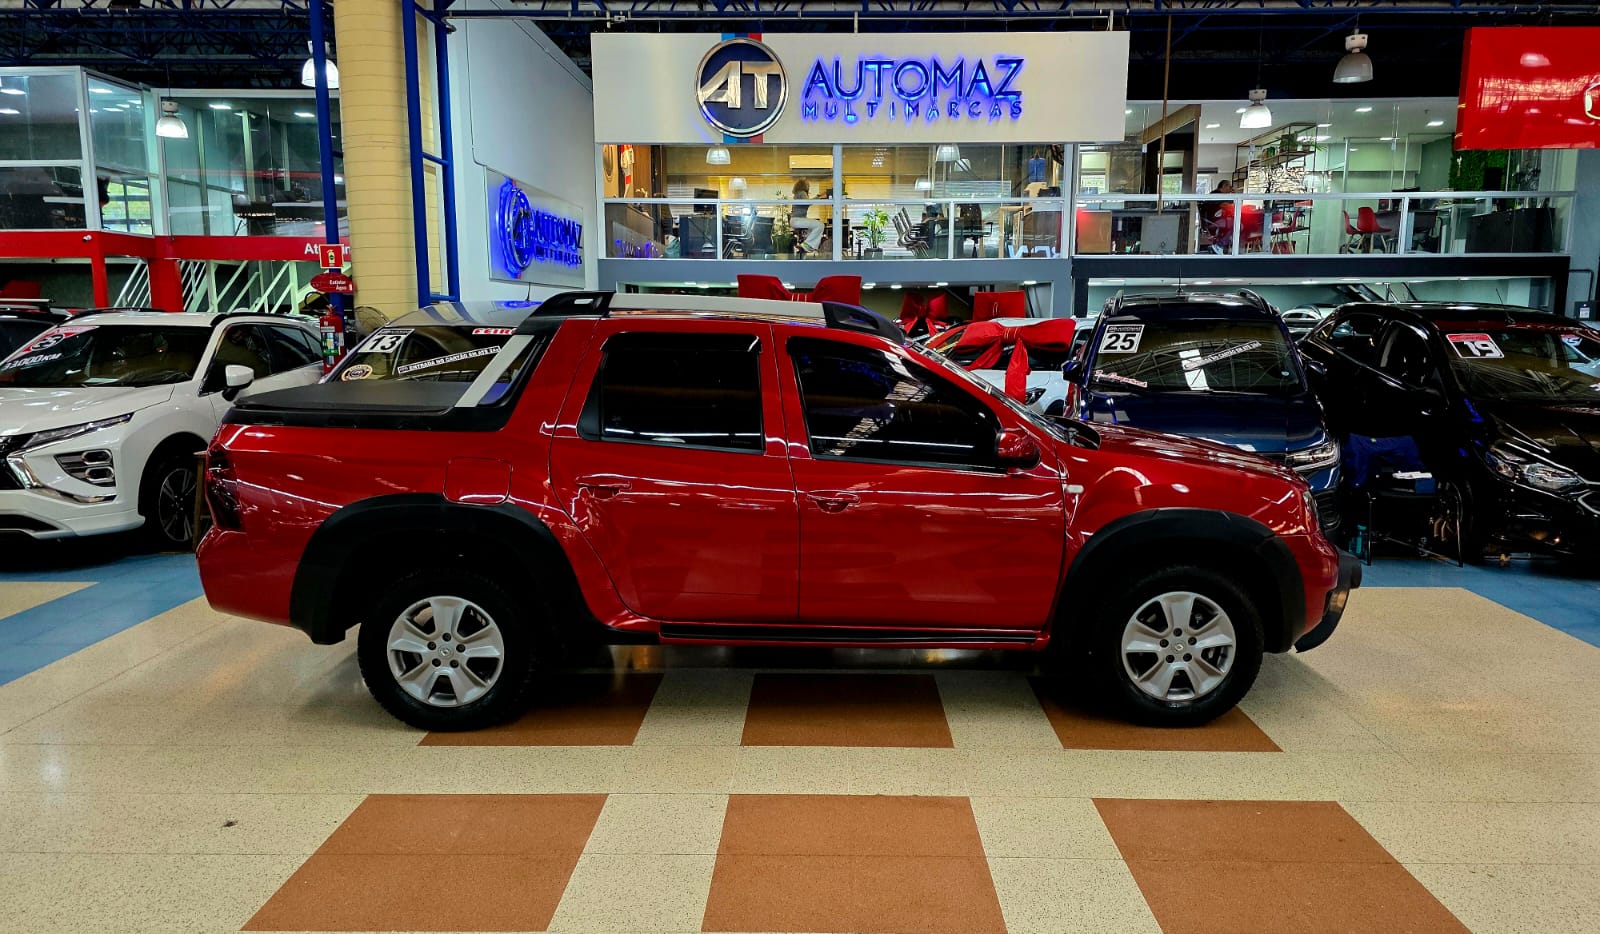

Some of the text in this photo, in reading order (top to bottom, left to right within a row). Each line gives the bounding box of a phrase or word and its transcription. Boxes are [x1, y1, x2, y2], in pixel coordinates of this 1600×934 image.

[804, 58, 1025, 100] AUTOMAZ
[804, 100, 1023, 120] MULTIMARCAS
[367, 335, 402, 351] 13
[1103, 333, 1137, 351] 25
[1463, 340, 1501, 357] 19
